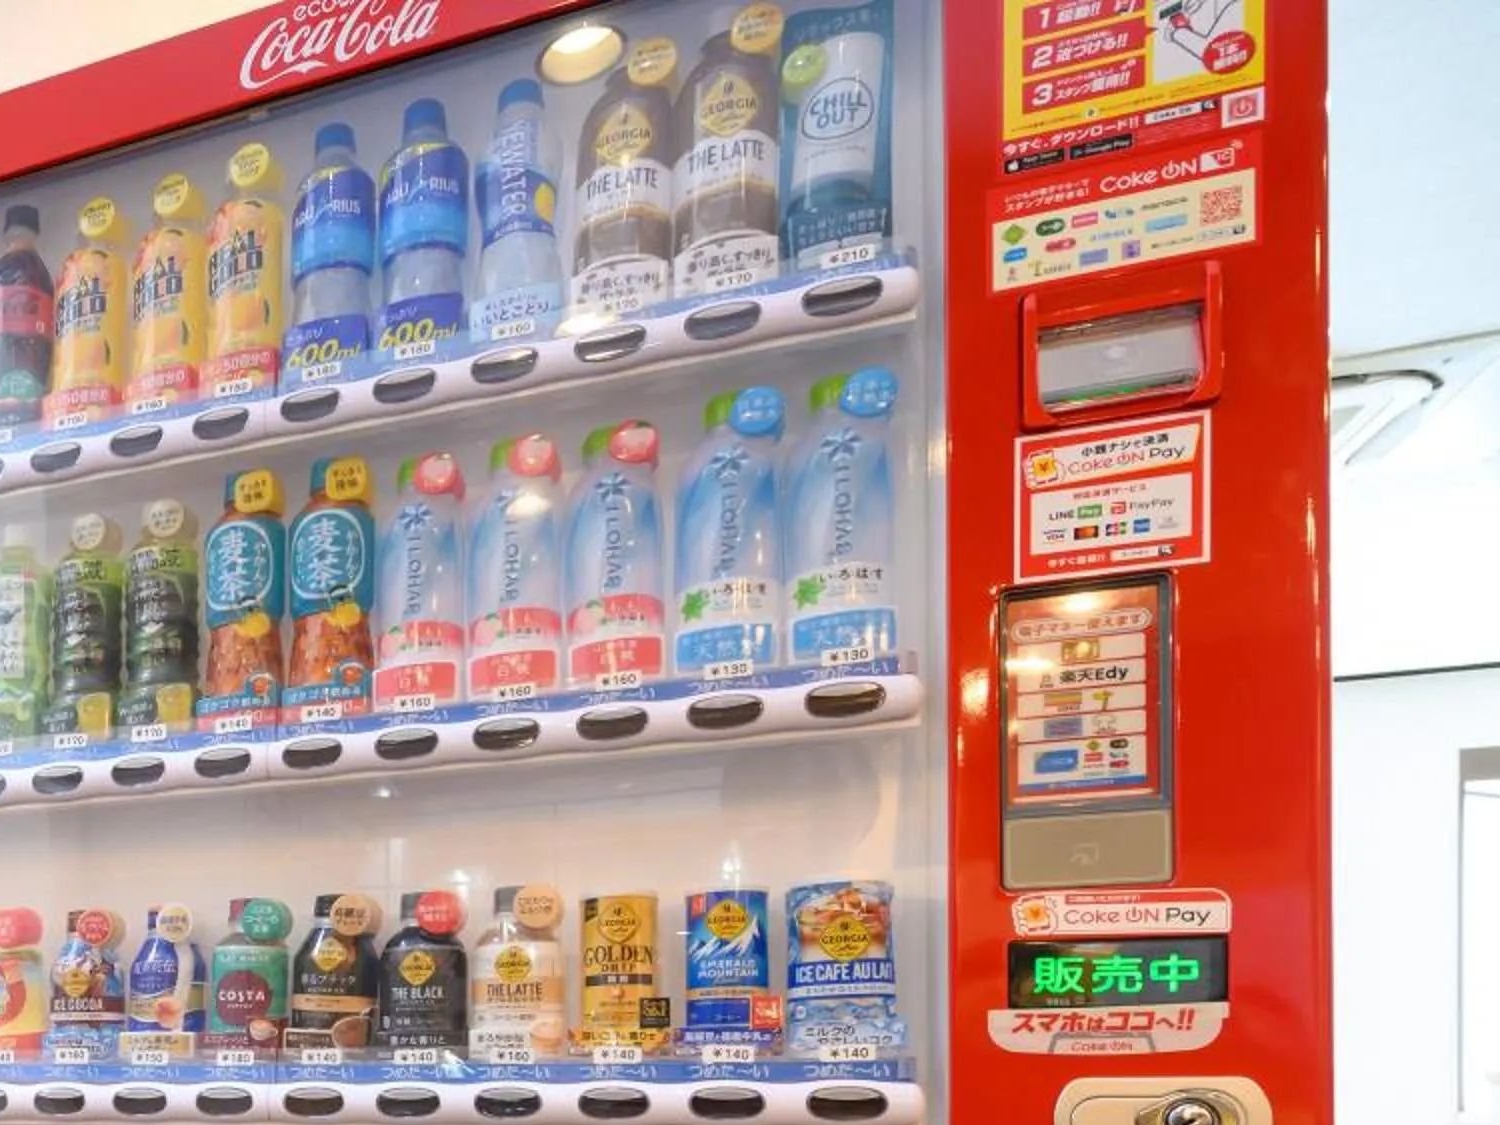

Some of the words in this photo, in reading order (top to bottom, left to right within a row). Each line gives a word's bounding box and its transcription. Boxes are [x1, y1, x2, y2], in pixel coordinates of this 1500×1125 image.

[1040, 8, 1051, 29] 1
[239, 0, 441, 90] Coca-Cola
[1031, 45, 1054, 69] 2
[809, 90, 869, 117] CHILL
[1031, 85, 1054, 107] 3
[815, 107, 860, 130] OUT
[687, 146, 718, 174] THE
[720, 139, 765, 166] LATTE
[586, 173, 612, 200] THE
[1098, 169, 1158, 194] Coke
[1160, 157, 1199, 181] ON
[828, 247, 870, 265] ¥210
[1067, 457, 1114, 476] Coke
[1148, 446, 1187, 461] Pay
[1047, 508, 1075, 521] LINE
[309, 517, 344, 590] 麦茶
[217, 529, 250, 602] 麦茶
[1064, 907, 1121, 926] Coke
[1165, 906, 1212, 928] Pay
[821, 933, 869, 945] GEORGIA
[584, 944, 654, 968] GOLDEN
[699, 959, 757, 969] EMERALD
[697, 968, 759, 979] MOUNTAIN
[795, 965, 814, 984] ICE
[815, 962, 851, 982] CAFE
[1033, 953, 1201, 995] 販売中
[218, 989, 266, 1002] COSTA
[506, 981, 543, 996] LATTE
[600, 1050, 636, 1060] ¥140
[713, 1049, 749, 1060] ¥140
[830, 1047, 869, 1059] ¥140
